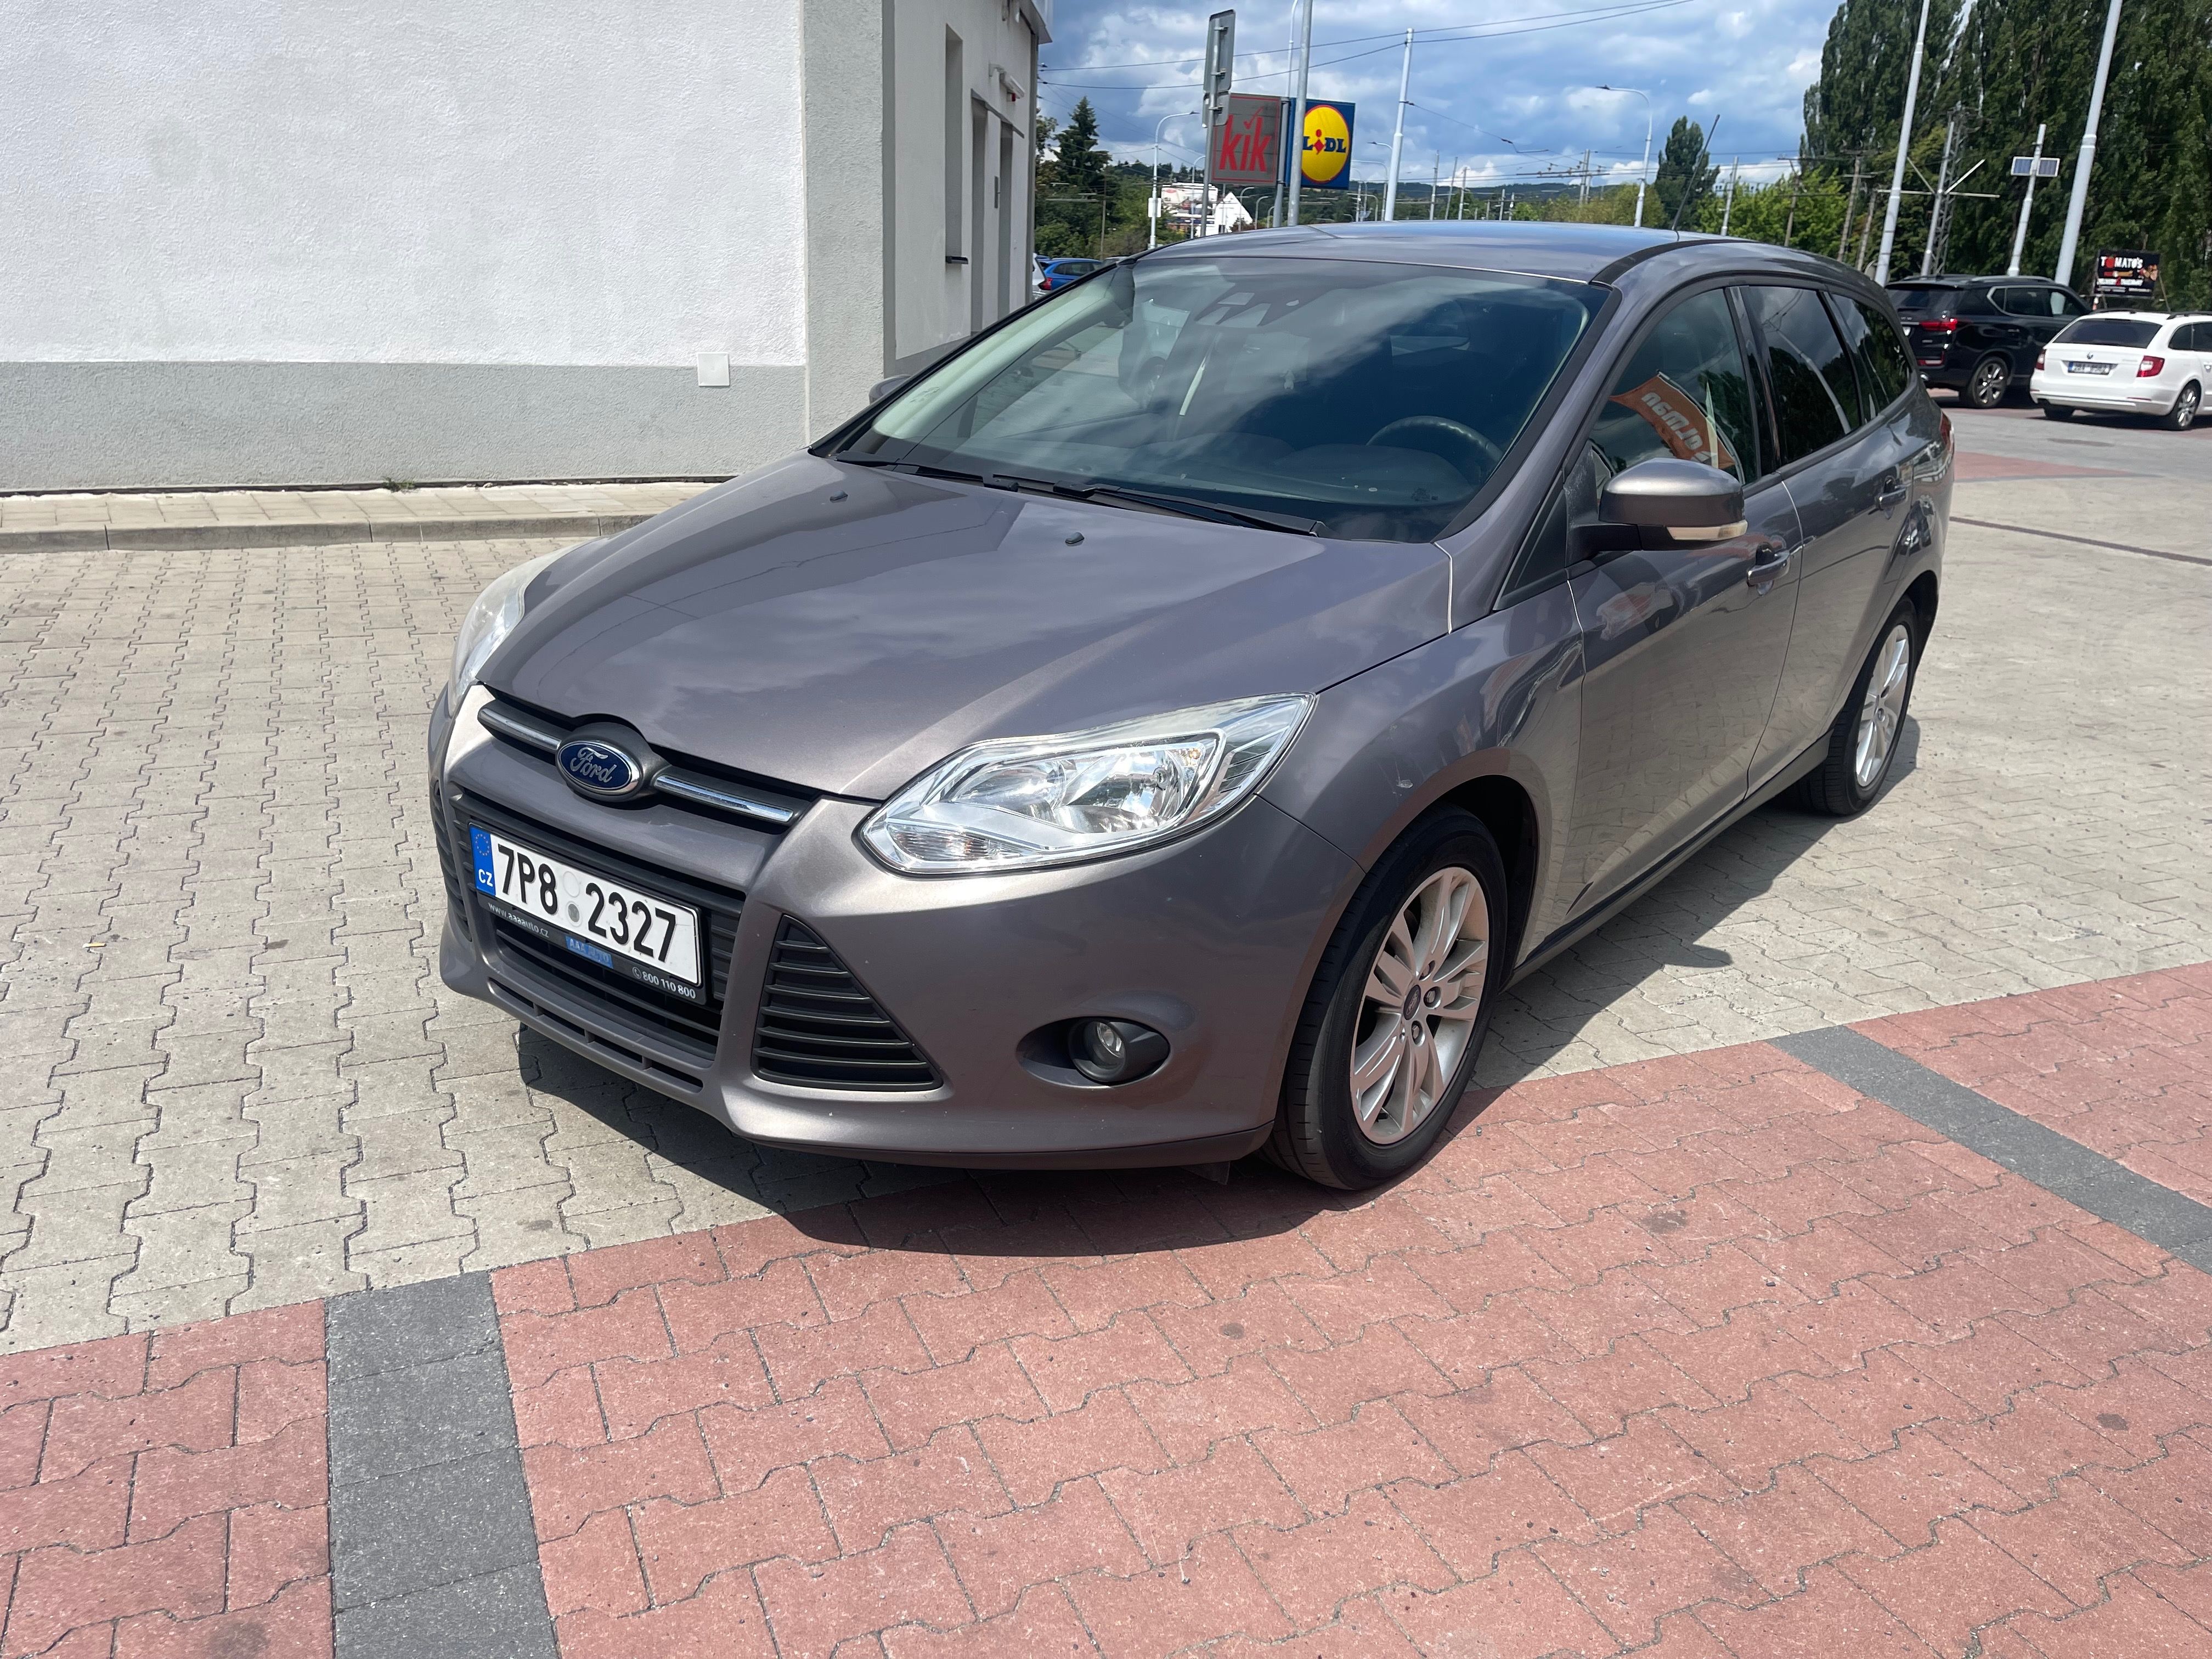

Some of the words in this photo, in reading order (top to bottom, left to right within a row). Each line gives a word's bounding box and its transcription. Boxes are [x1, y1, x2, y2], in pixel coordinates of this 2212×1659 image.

[570, 747, 617, 783] Ford
[478, 869, 493, 887] CZ
[488, 902, 549, 938] www.aaaauto.cz
[498, 844, 558, 915] 7P8
[585, 882, 676, 963] 2327
[642, 971, 659, 985] 800
[661, 979, 676, 992] 110
[678, 985, 696, 1000] 800
